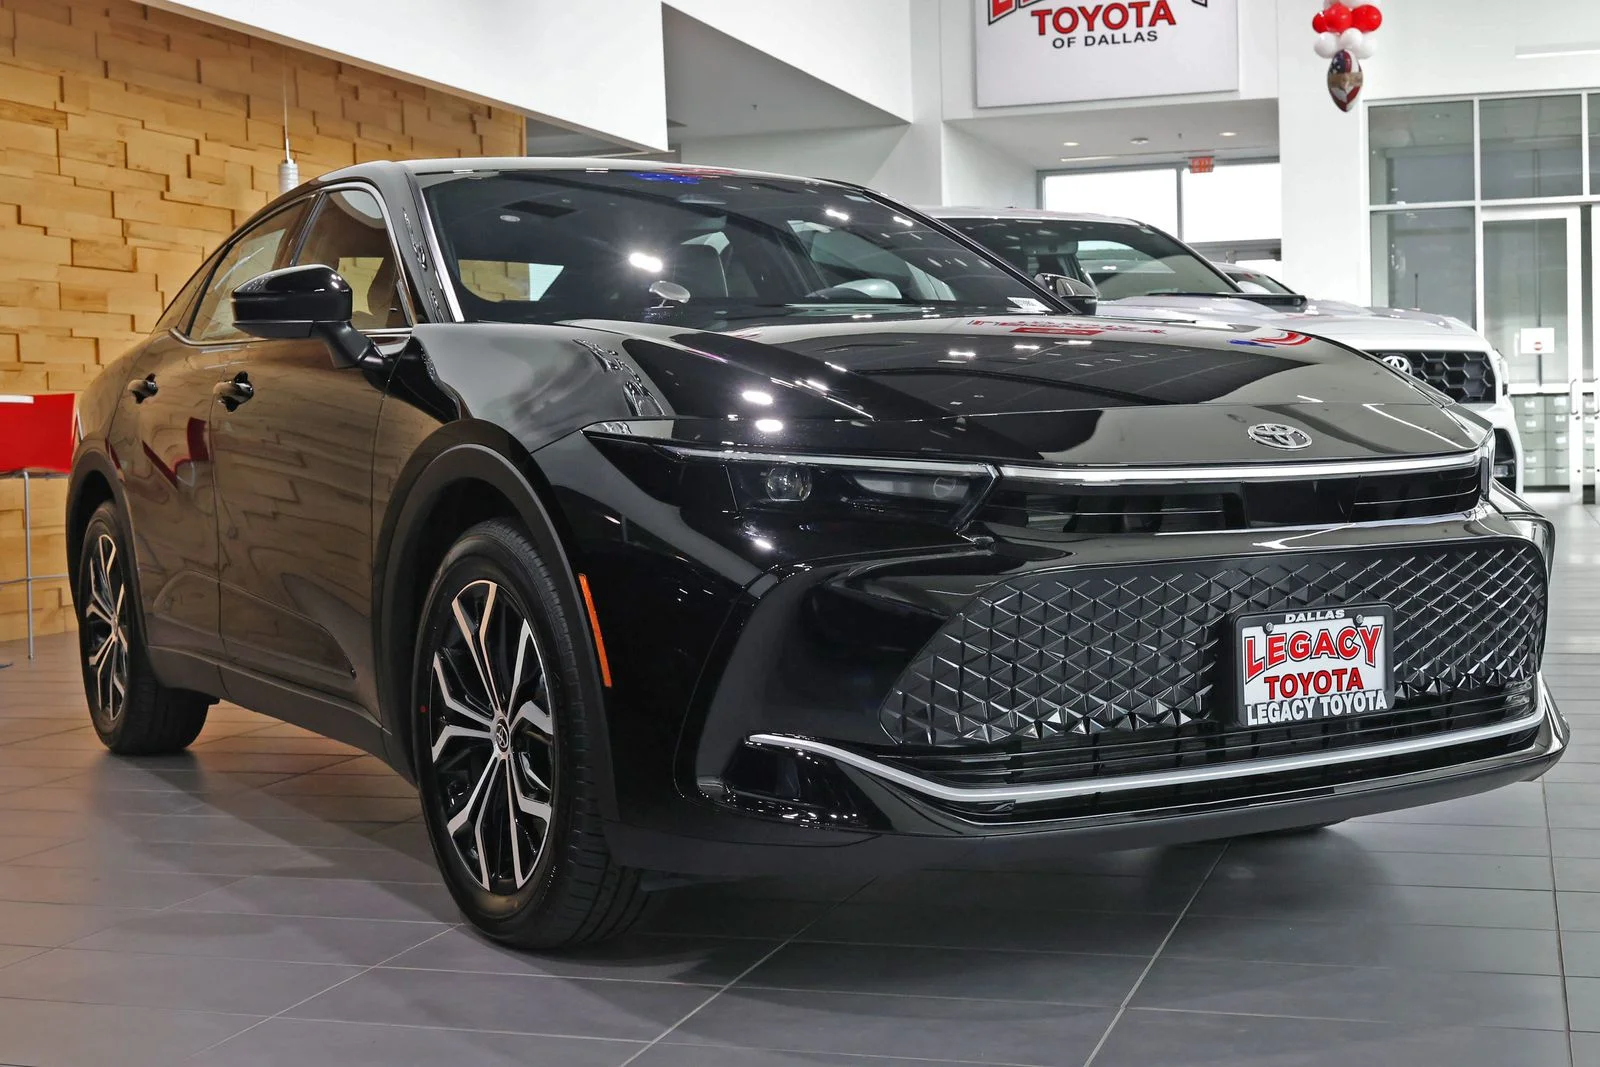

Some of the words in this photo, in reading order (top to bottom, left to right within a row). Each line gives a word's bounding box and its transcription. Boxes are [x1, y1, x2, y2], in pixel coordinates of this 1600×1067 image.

[1031, 0, 1176, 36] TOYOTA
[1052, 36, 1077, 49] OF
[1084, 30, 1158, 47] DALLAS
[1285, 609, 1345, 623] DALLAS
[1244, 624, 1383, 685] LEGACY
[1264, 667, 1364, 700] TOYOTA
[1247, 699, 1315, 726] LEGACY
[1320, 690, 1388, 716] TOYOTA
